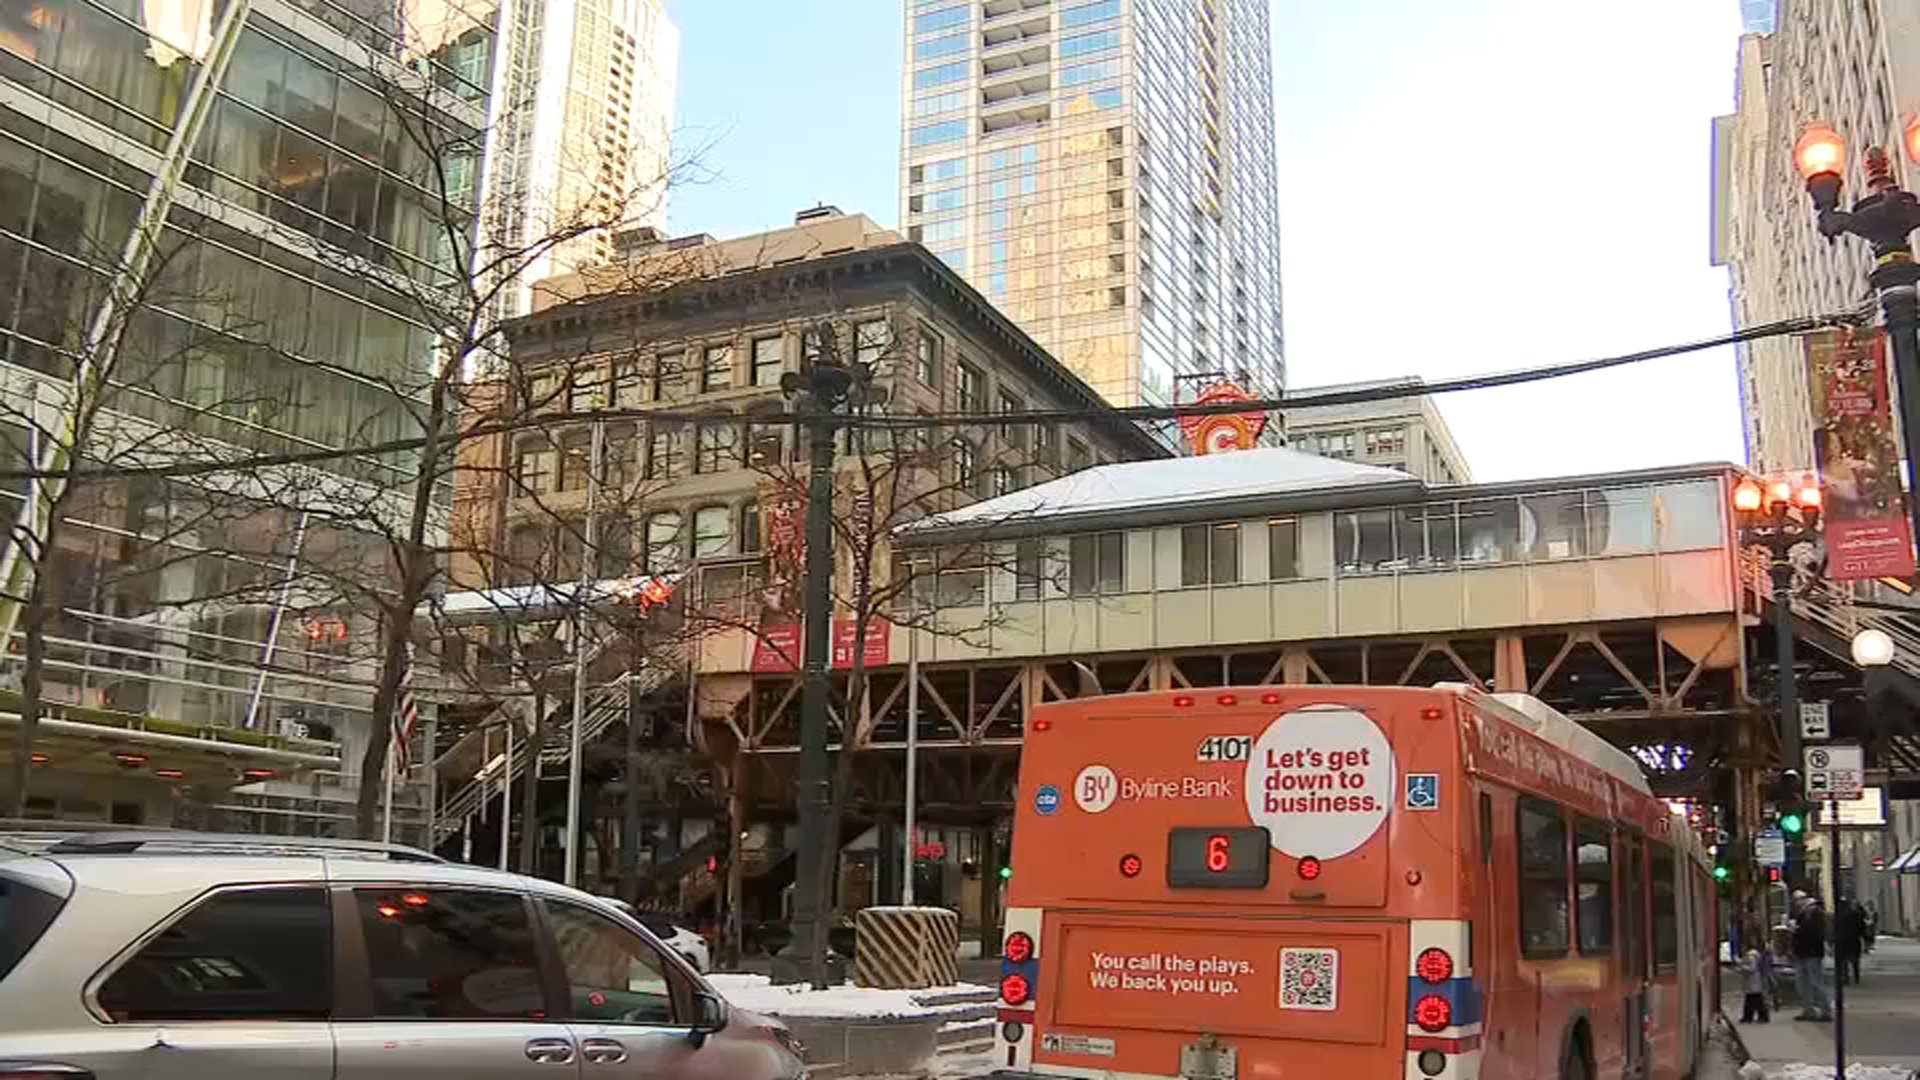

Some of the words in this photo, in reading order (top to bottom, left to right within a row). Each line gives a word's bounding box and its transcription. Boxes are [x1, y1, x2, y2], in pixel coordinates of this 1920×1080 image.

[1199, 738, 1250, 760] 4101
[1266, 748, 1323, 769] Let's
[1328, 747, 1370, 771] get
[1083, 776, 1110, 802] BY
[1121, 778, 1180, 800] Byline
[1182, 777, 1231, 798] Bank
[1265, 769, 1333, 790] down
[1339, 771, 1365, 789] to
[1265, 791, 1382, 813] business.
[1209, 836, 1228, 871] 6
[1092, 953, 1124, 969] You
[1127, 953, 1160, 971] call
[1164, 954, 1195, 972] the
[1199, 955, 1255, 977] plays.
[1090, 972, 1118, 989] We
[1122, 972, 1166, 990] back
[1170, 976, 1205, 996] you
[1209, 979, 1239, 997] up.
